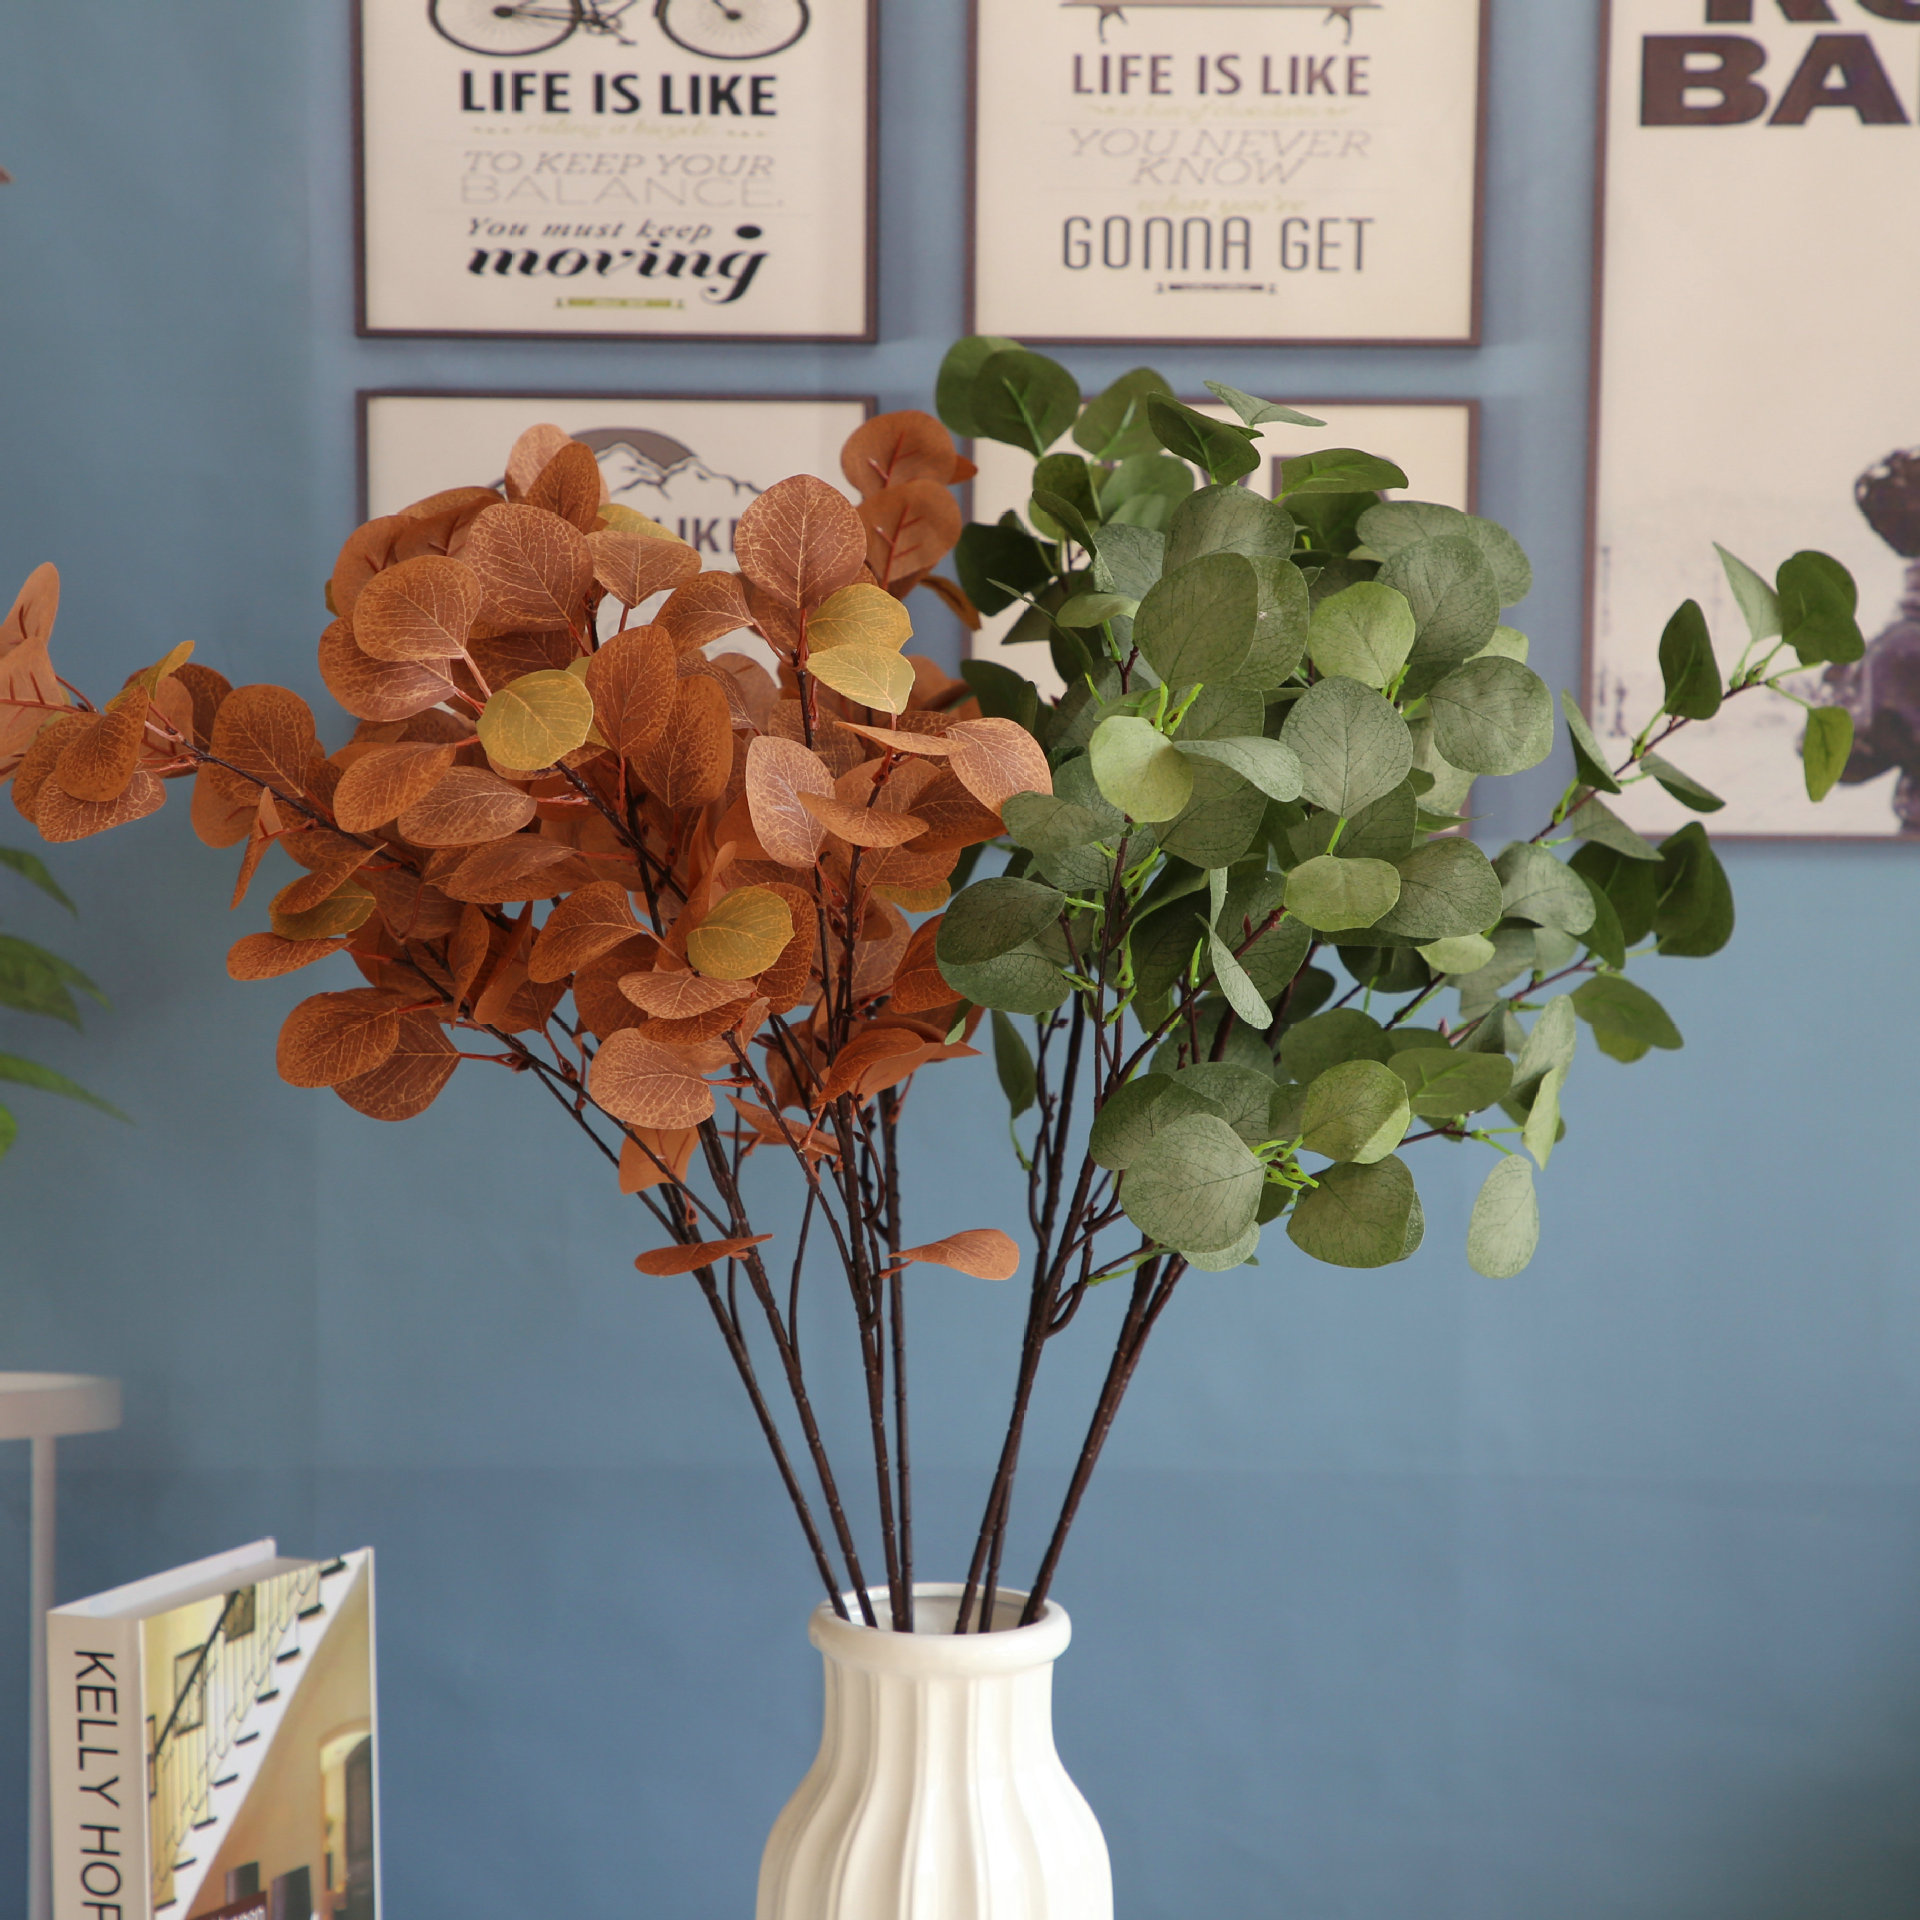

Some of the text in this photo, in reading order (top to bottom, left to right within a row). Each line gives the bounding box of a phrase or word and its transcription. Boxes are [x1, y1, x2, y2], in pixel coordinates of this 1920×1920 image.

[461, 70, 777, 116] LIFE IS LIKE
[1073, 54, 1371, 96] LIFE IS LIKE
[1639, 33, 1920, 127] BA
[464, 150, 775, 177] TO KEEP YOUR
[1069, 127, 1372, 158] YOU NEVER
[1129, 156, 1308, 186] KNOW
[467, 217, 713, 243] You must keep
[1062, 215, 1375, 272] GONNA GET
[467, 225, 769, 304] moving
[74, 1650, 120, 1809] KELLY
